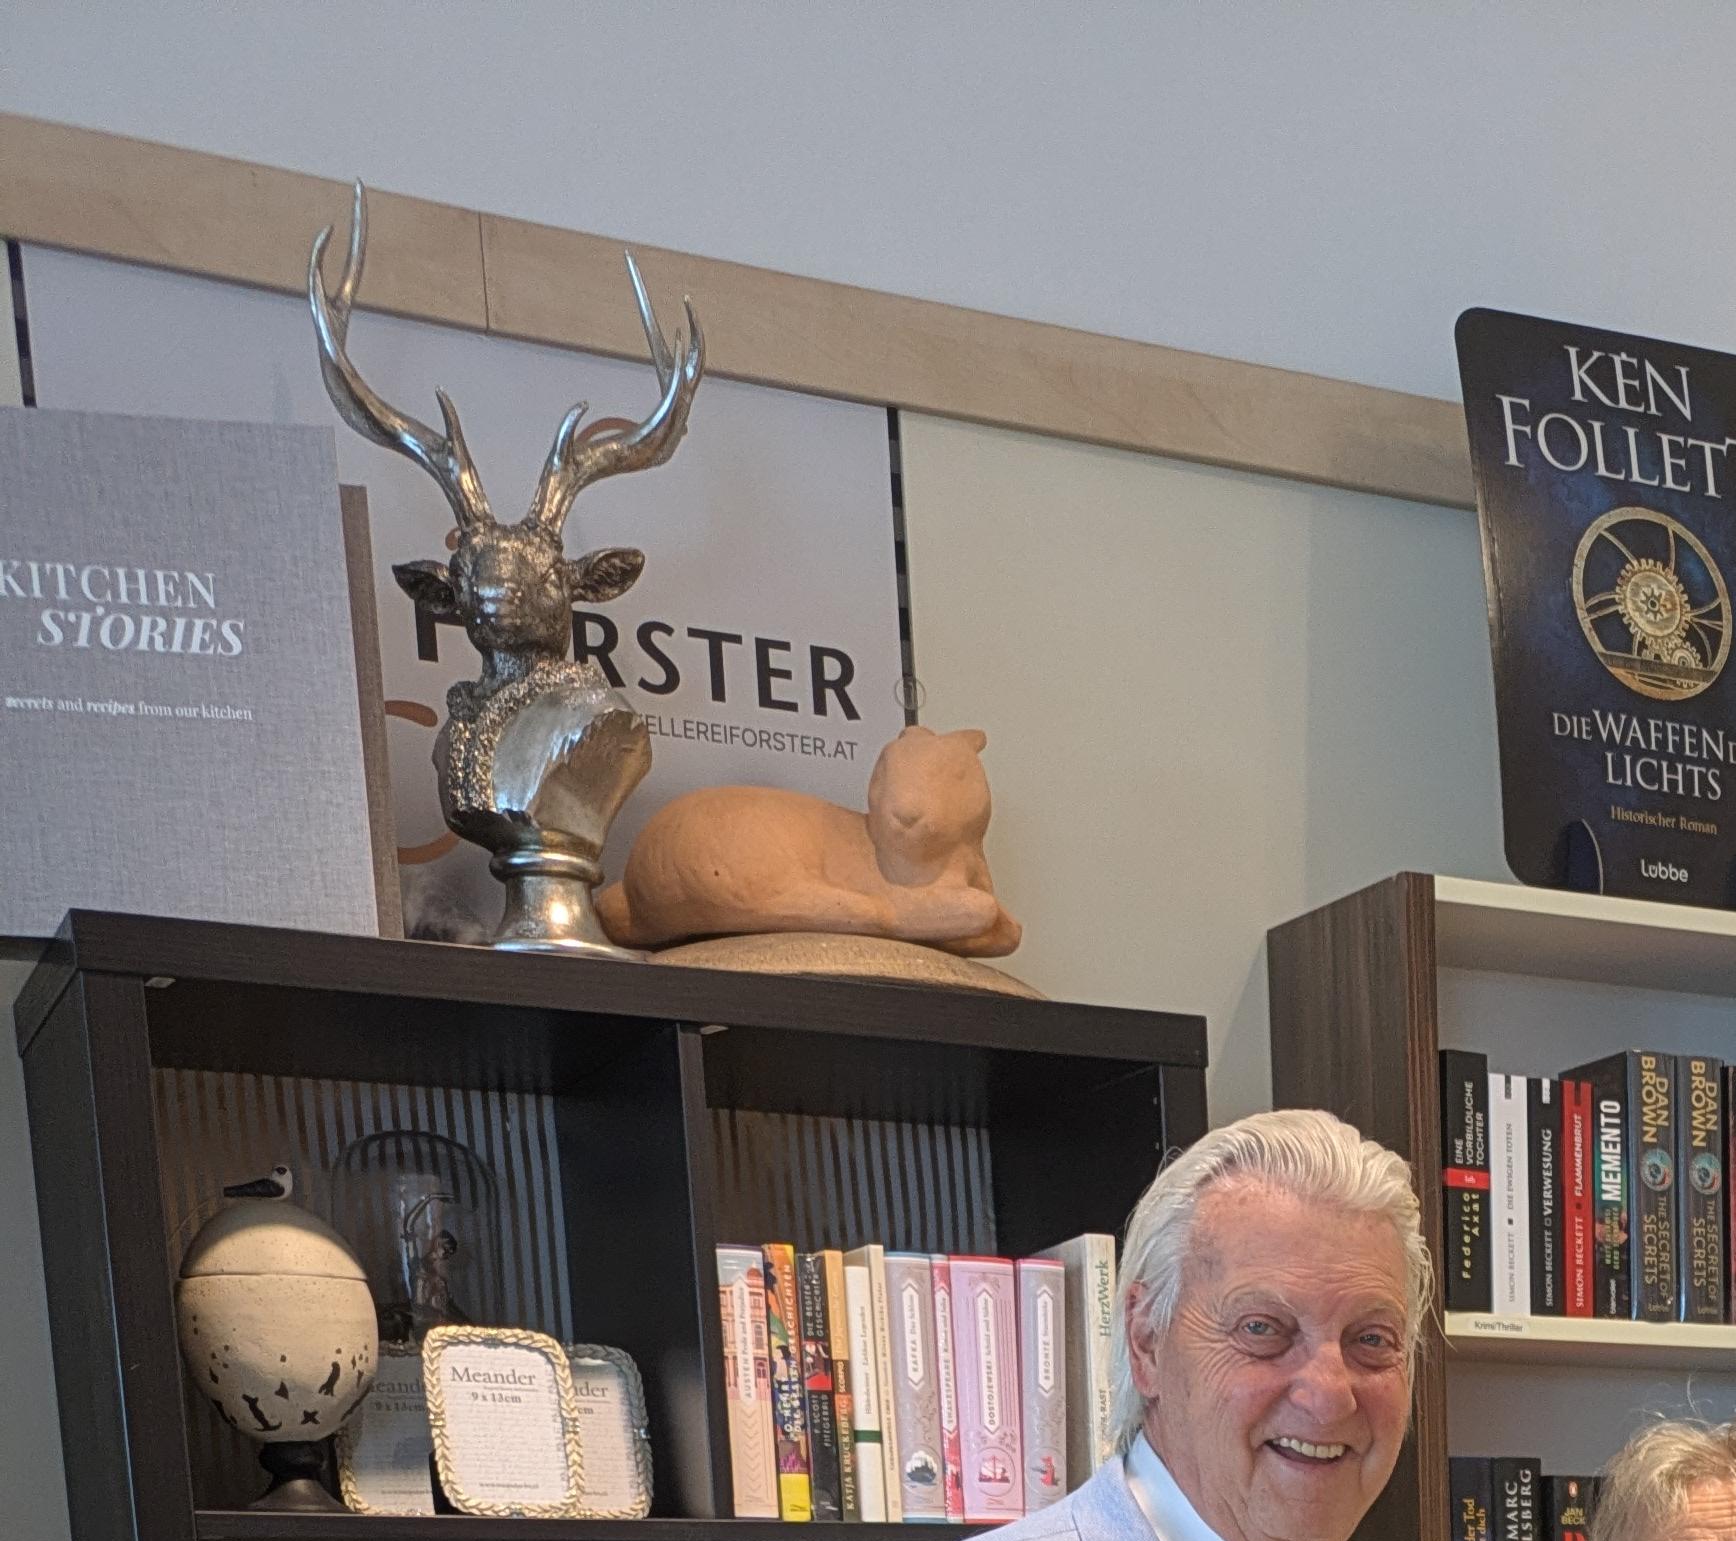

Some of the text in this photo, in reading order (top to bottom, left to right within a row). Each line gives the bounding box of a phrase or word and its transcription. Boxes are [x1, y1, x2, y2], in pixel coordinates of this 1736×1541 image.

[1564, 345, 1693, 422] KEN
[0, 560, 216, 609] KITCHEN
[37, 606, 245, 656] STORIES
[414, 598, 861, 721] FRSTER
[57, 698, 82, 712] and
[87, 699, 135, 716] recipes
[138, 701, 173, 717] from
[175, 706, 200, 718] our
[202, 703, 253, 721] kitchen
[1553, 712, 1593, 742] DIE
[1593, 709, 1729, 762] WAFFEN
[643, 714, 859, 761] ELLEREIFORSTER.AT
[1605, 750, 1722, 801] LICHTS
[1611, 805, 1718, 836] Historischer Roman
[1464, 1081, 1474, 1165] VORBILDLICHE
[1641, 1055, 1658, 1143] BROWN
[1655, 1077, 1669, 1126] DAN
[1691, 1061, 1707, 1147] BROWN
[1704, 1082, 1718, 1130] DAN
[1476, 1112, 1485, 1166] TOCHTER
[1600, 1099, 1621, 1201] MEMENTO
[1542, 1128, 1553, 1216] VERWESUNG
[1461, 1192, 1472, 1280] Federico
[1472, 1192, 1481, 1237] Axat
[1574, 1114, 1585, 1308] SIMON BECKETT FLAMMENBRUT
[1644, 1214, 1658, 1285] SECRETS
[1657, 1212, 1670, 1279] SECRET
[1693, 1218, 1707, 1288] SECRETS
[1706, 1217, 1719, 1282] SECRET
[784, 1264, 797, 1354] GESCHICHTEN
[1095, 1259, 1111, 1338] HerzWerk
[450, 1366, 537, 1386] Meander
[836, 1362, 846, 1393] SCORPIO
[910, 1339, 919, 1373] KAFKA
[471, 1391, 479, 1401] 9
[985, 1360, 996, 1426] DOSTOJEWSKI
[844, 1477, 855, 1510] KATJA
[1463, 1498, 1475, 1520] Tod
[1505, 1481, 1518, 1541] MARC
[1561, 1515, 1585, 1525] BECK
[1564, 1507, 1584, 1517] JAN
[1475, 1508, 1487, 1535] dich
